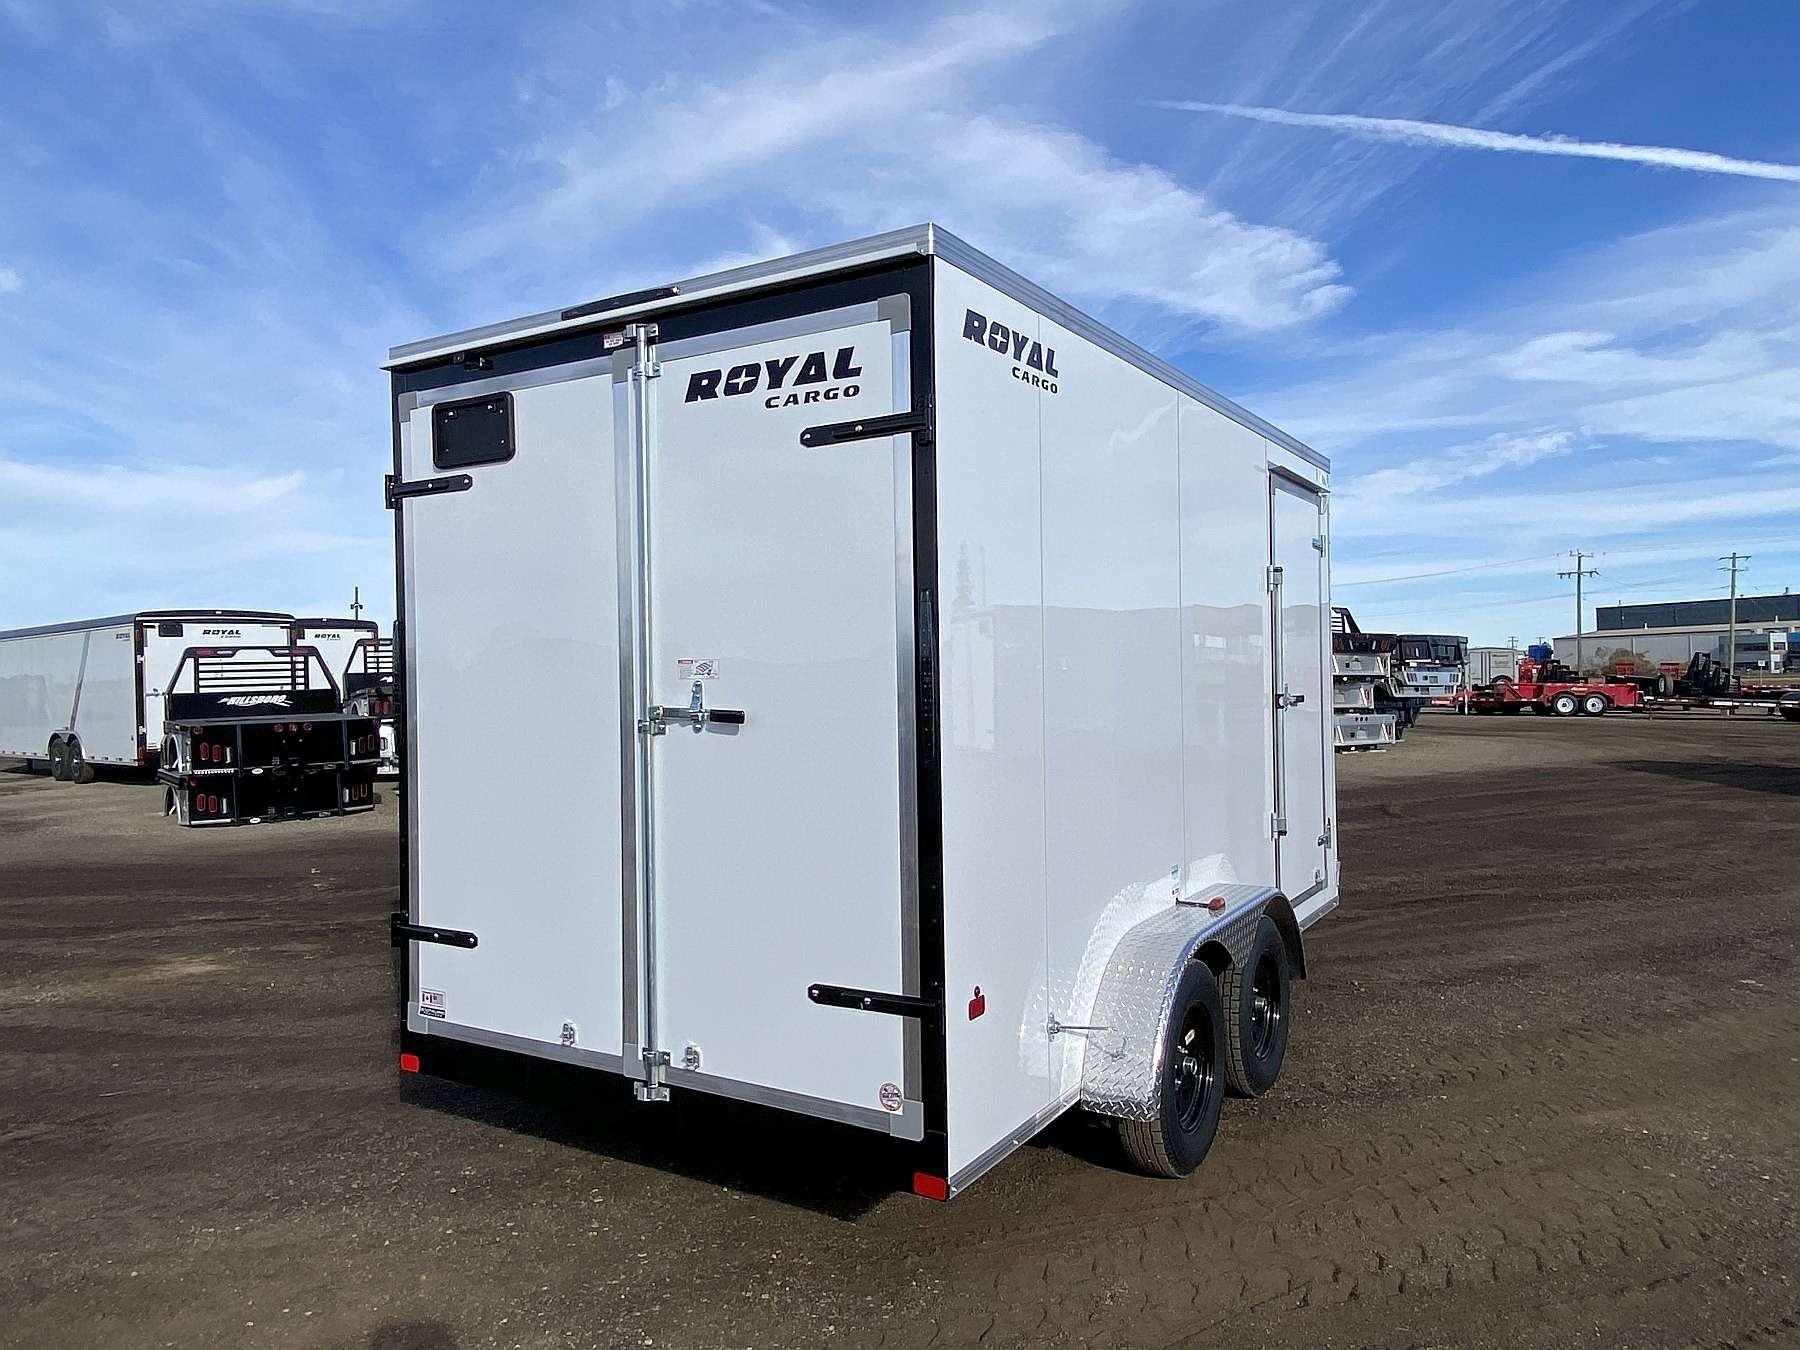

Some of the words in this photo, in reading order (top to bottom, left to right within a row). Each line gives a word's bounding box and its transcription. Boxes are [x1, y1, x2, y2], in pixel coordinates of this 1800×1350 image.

[962, 308, 1060, 380] ROYAL
[684, 345, 863, 404] ROYAL
[1011, 366, 1060, 395] CARGO
[764, 385, 860, 409] CARGO
[225, 694, 288, 706] HILLSBORO
